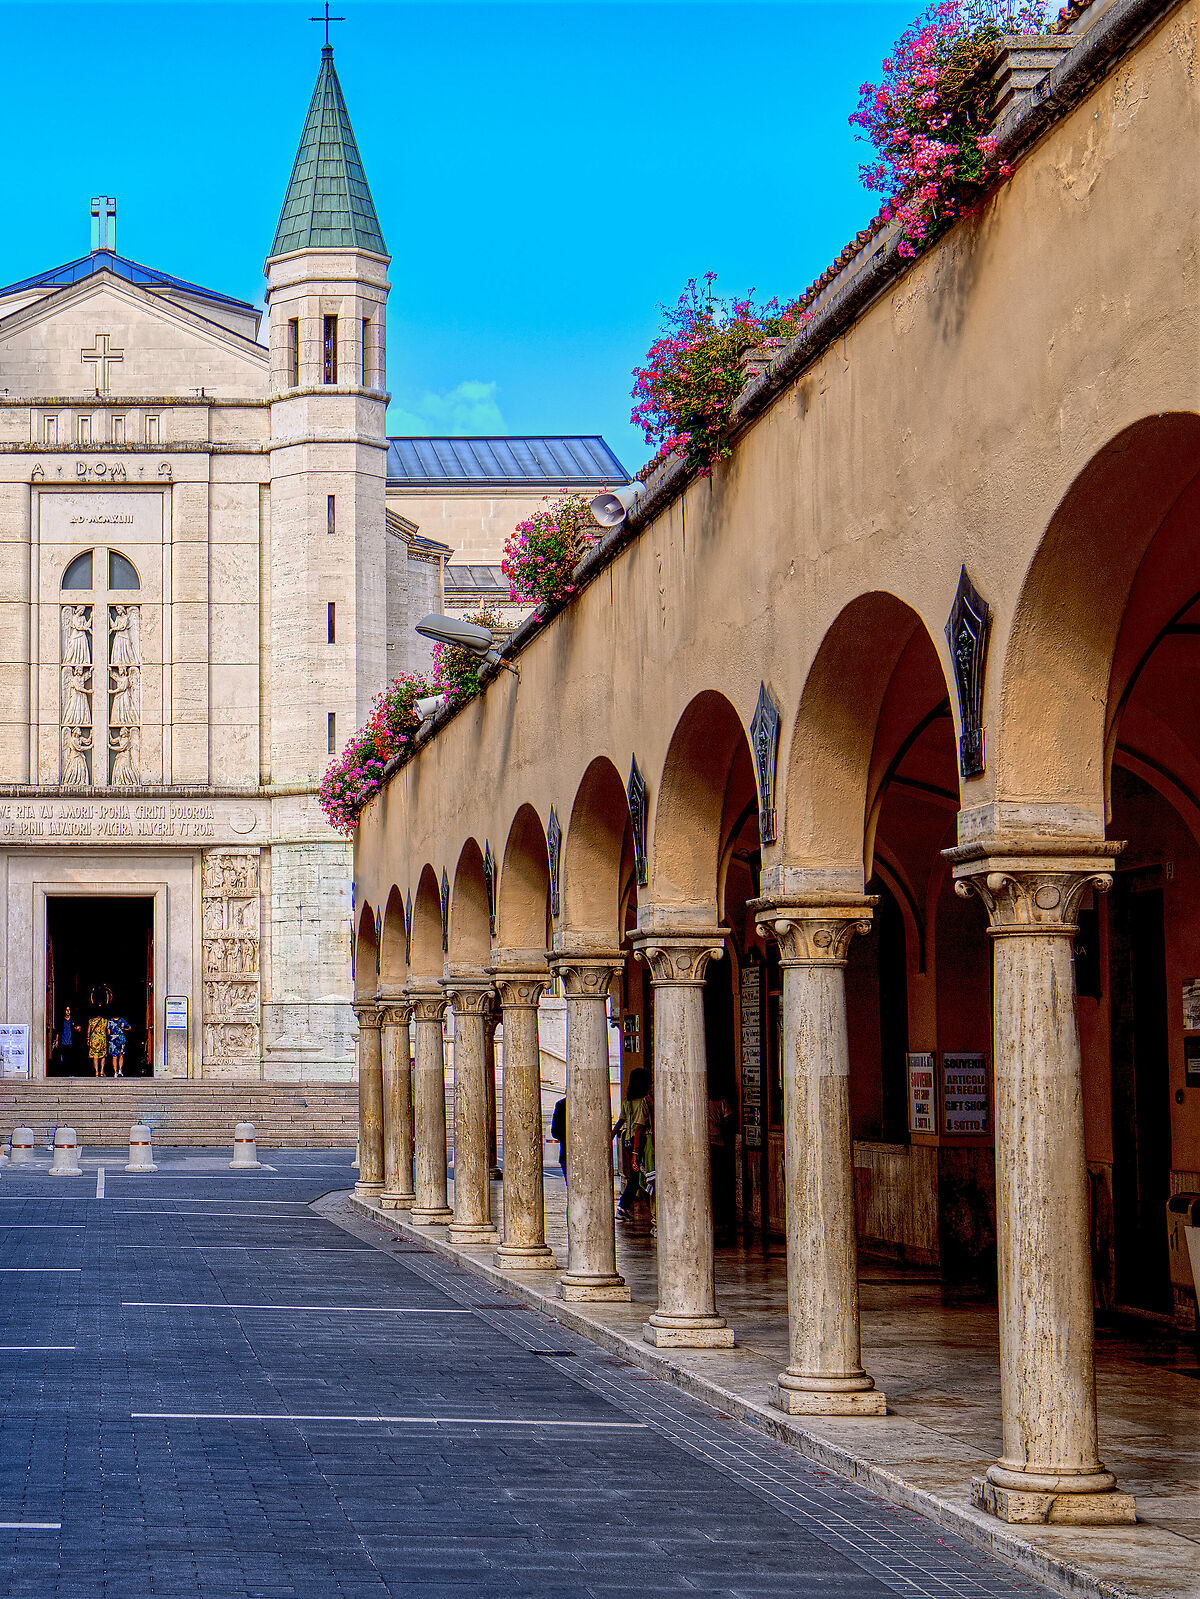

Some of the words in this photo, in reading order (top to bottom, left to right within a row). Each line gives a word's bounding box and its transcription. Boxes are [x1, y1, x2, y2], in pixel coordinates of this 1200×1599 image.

[16, 805, 35, 819] RITA
[40, 805, 54, 819] VAS
[134, 805, 166, 819] CHRISTI
[170, 805, 215, 819] DOLOROSA
[4, 822, 15, 836] DE
[18, 822, 44, 836] SPINIS
[137, 822, 175, 836] NASCERIS
[193, 822, 215, 836] ROSA
[946, 1075, 985, 1084] ARTICOLI
[944, 1086, 957, 1095] DA
[957, 1086, 988, 1095] REGALO
[945, 1100, 964, 1111] GIFT
[964, 1100, 988, 1111] SHOP
[953, 1120, 980, 1130] SOTTO
